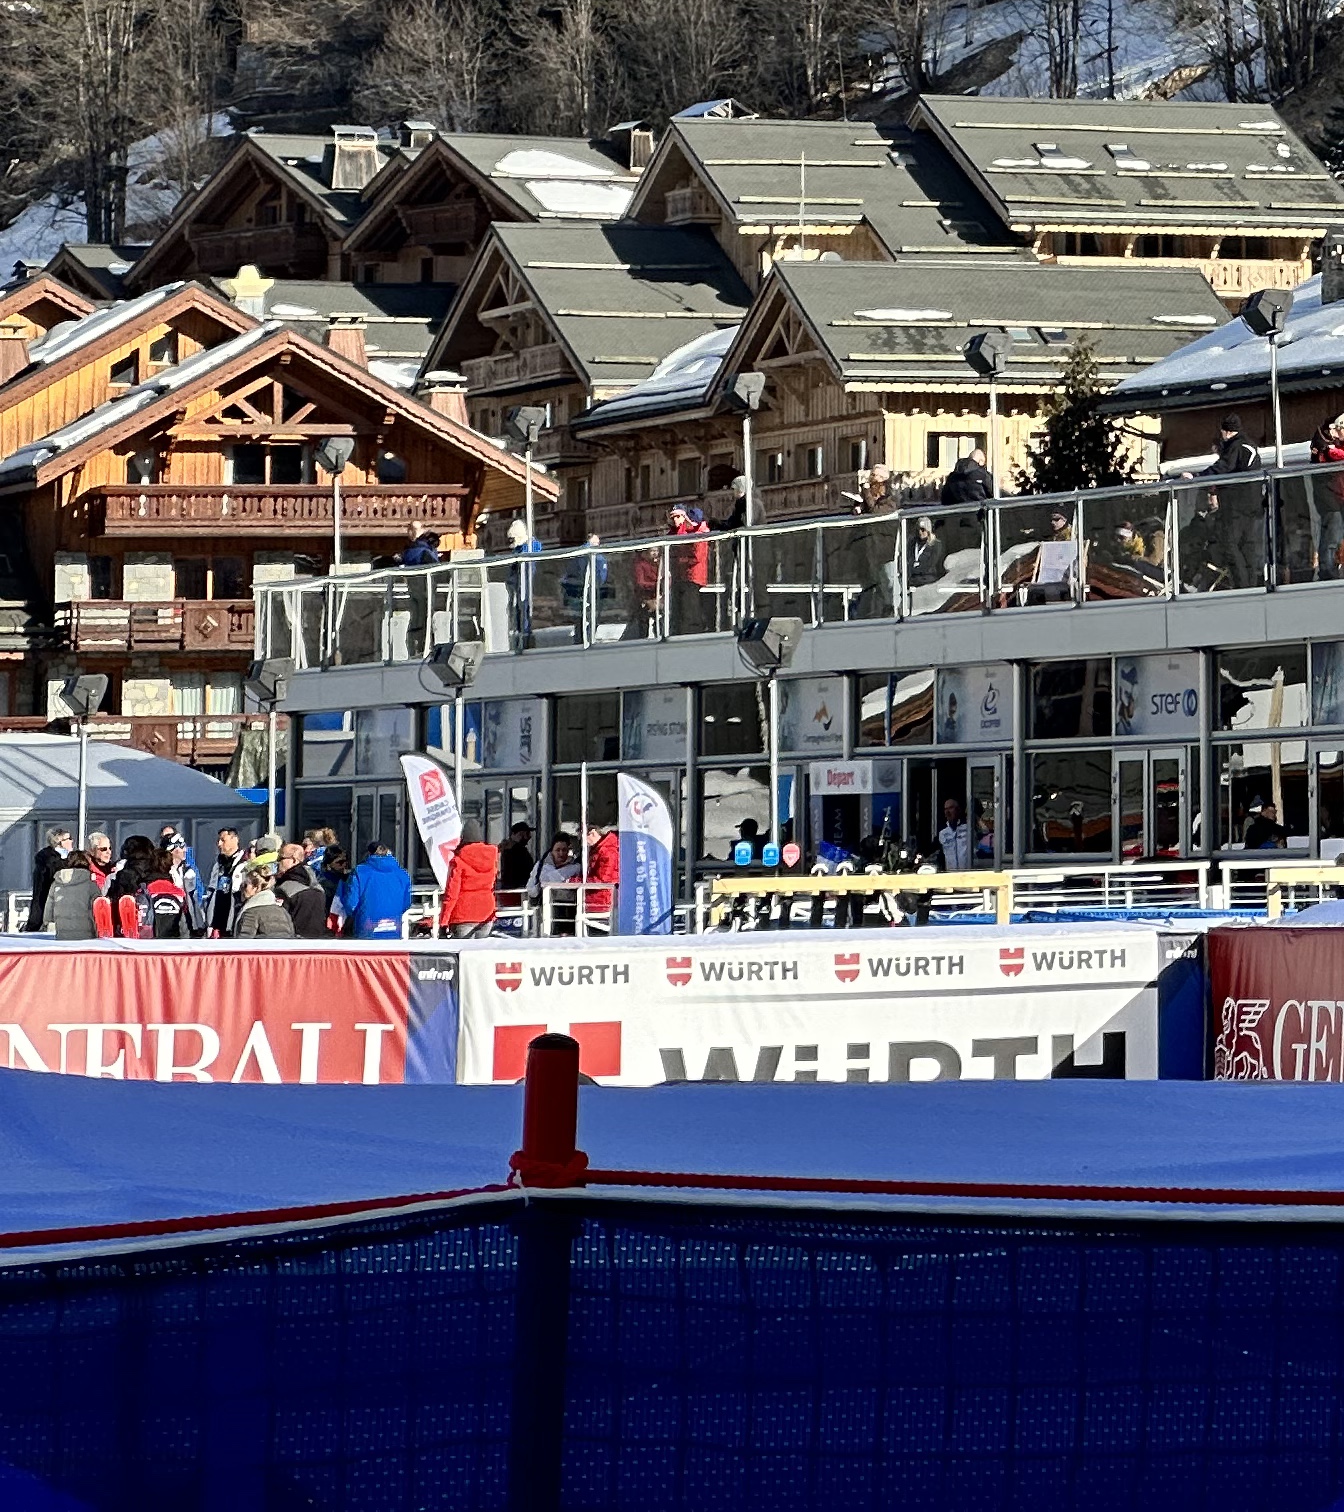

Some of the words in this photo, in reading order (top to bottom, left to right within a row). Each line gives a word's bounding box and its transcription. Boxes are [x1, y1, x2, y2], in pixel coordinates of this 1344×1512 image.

[532, 965, 628, 987] WÜRTH
[701, 962, 798, 982] WÜRTH
[868, 956, 964, 977] WÜRTH
[1033, 948, 1126, 970] WÜRTH
